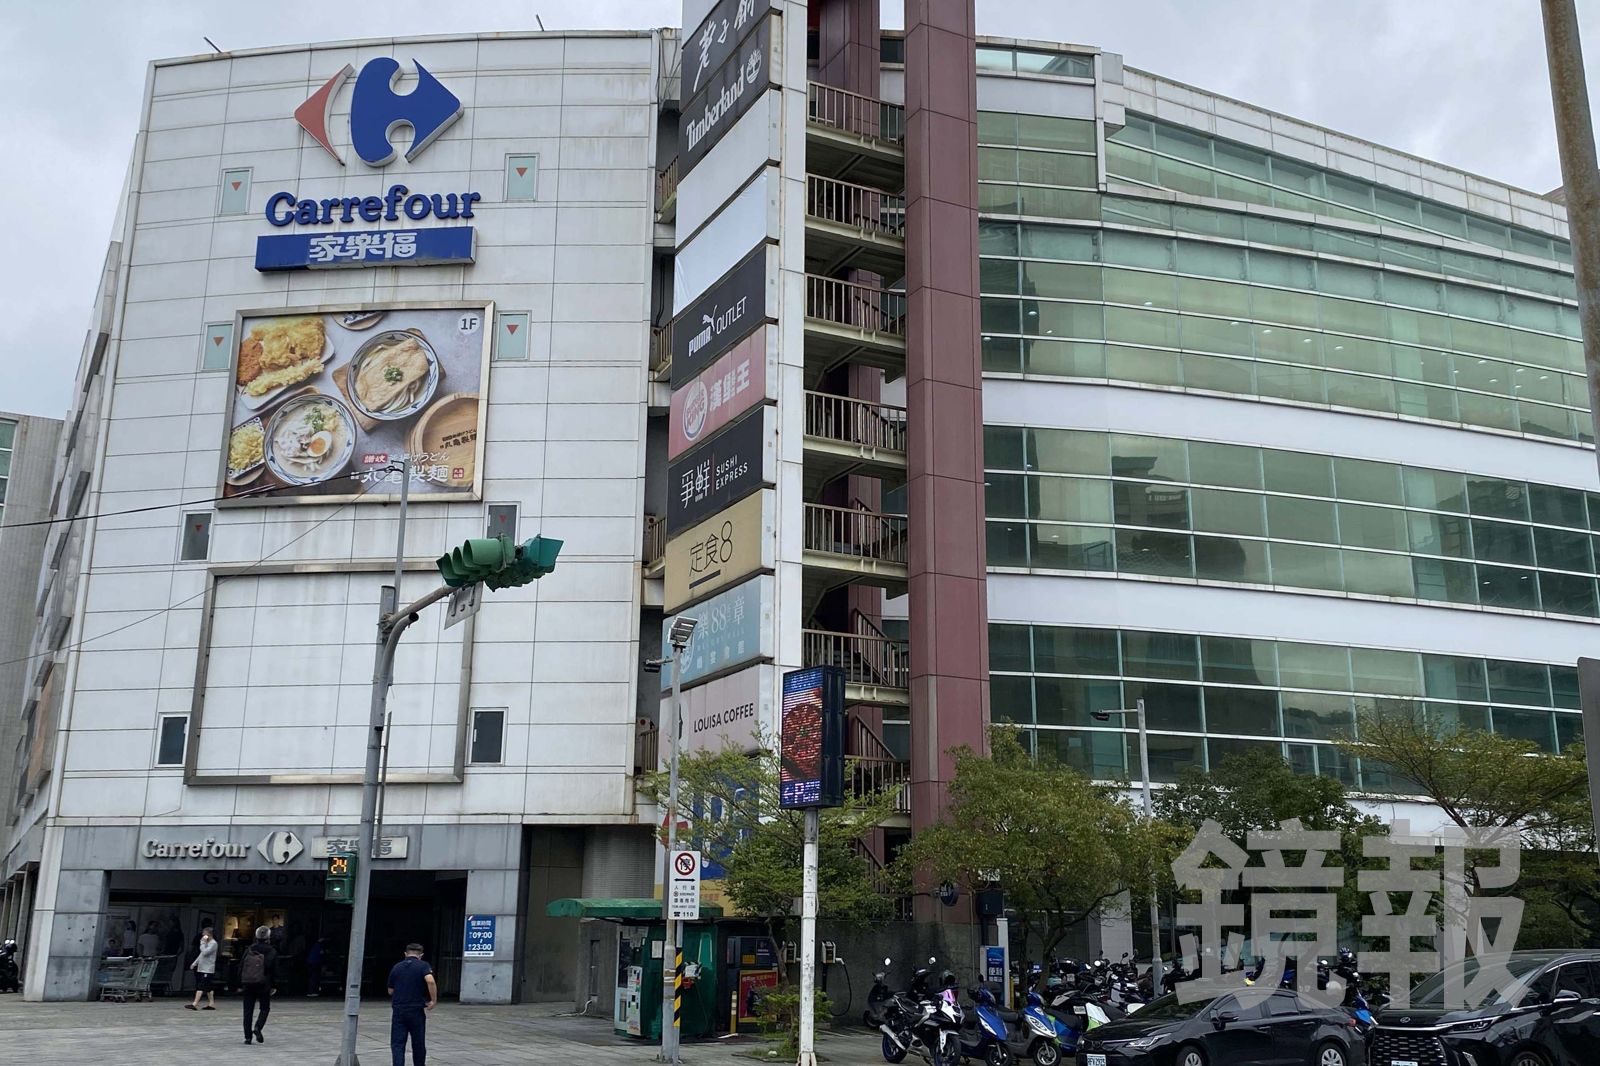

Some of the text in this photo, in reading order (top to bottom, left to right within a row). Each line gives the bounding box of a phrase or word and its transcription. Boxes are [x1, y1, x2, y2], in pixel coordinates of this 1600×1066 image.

[686, 64, 744, 152] Timberland
[265, 184, 481, 227] Carrefour
[309, 232, 418, 261] 家樂福
[460, 317, 478, 331] 1F
[688, 296, 747, 357] PUMA OUTLET
[716, 454, 738, 476] SUSHI
[716, 462, 748, 490] EXPRESS
[680, 459, 710, 509] 爭鮮
[689, 520, 733, 577] 定食8
[693, 702, 754, 733] LOUISA COFFEE
[143, 837, 250, 859] Carrefour
[202, 870, 327, 885] GIORDAN
[331, 857, 347, 874] 24
[471, 943, 492, 951] 23:00
[472, 931, 493, 939] 09:00
